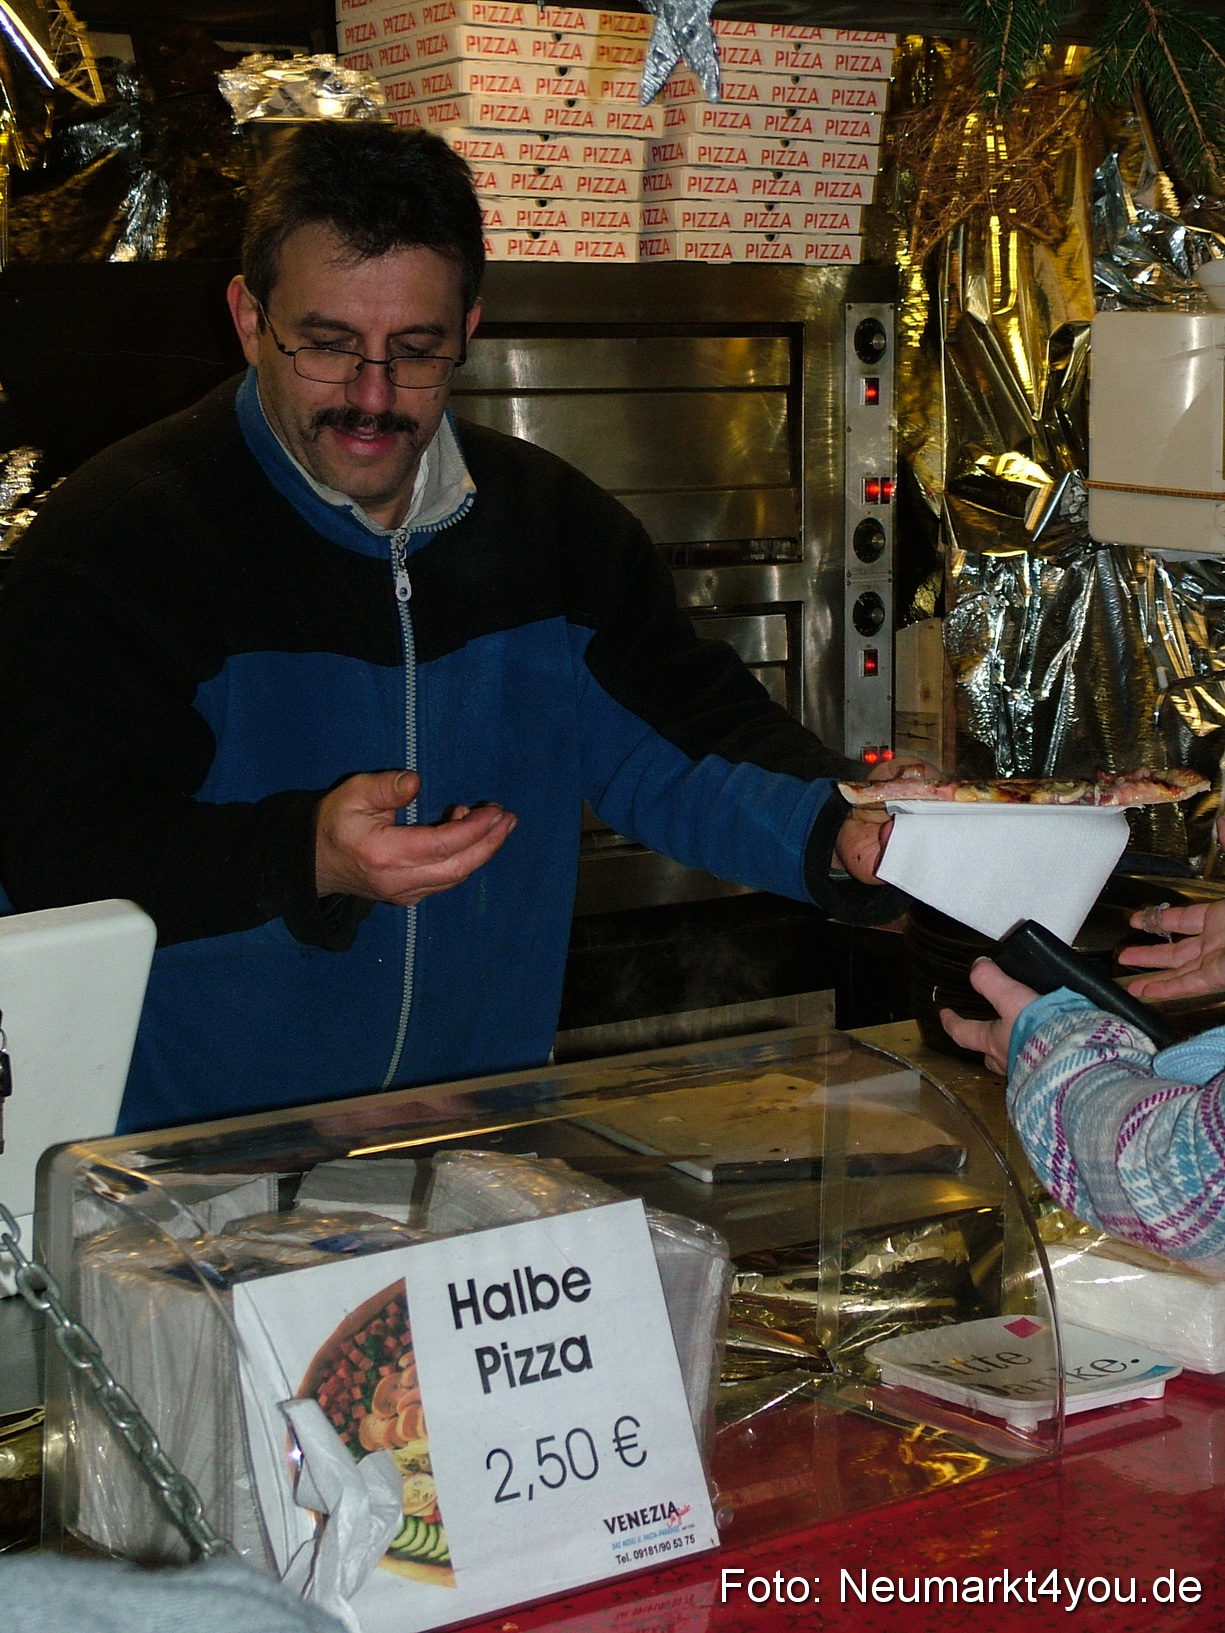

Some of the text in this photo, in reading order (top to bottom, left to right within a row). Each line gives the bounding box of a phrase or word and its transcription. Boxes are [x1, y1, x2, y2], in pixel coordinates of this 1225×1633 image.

[345, 2, 456, 45] PIZZA PIZZA PIZZA
[472, 4, 647, 33] PIZZA PIZZA PIZZA
[379, 43, 411, 66] PIZZA
[416, 34, 449, 56] PIZZA
[466, 35, 519, 56] PIZZA
[532, 41, 584, 61] PIZZA
[775, 50, 823, 70] PIZZA
[835, 55, 882, 73] PIZZA
[385, 73, 454, 102] PIZZA PIZZA
[470, 74, 638, 98] PIZZA PIZZA PIZZ
[719, 83, 877, 107] IZZA PIZZA PIZZA
[428, 102, 461, 124] PIZZA
[480, 104, 654, 131] PIZZA PIZZA PIZZA
[663, 109, 686, 127] ZZA
[702, 110, 871, 137] PIZZA PIZZA PIZZA
[453, 141, 633, 164] PIZZA PIZZA PIZZA
[651, 143, 684, 163] PIZZA
[697, 146, 869, 170] PIZZA PIZZA PIZZA
[511, 173, 563, 191] PIZZA
[576, 176, 628, 194] PIZZA
[642, 173, 672, 192] PIZZA
[687, 176, 862, 199] PIZZA PIZZA PIZZA
[517, 210, 568, 227] PIZZA
[581, 211, 631, 228] PIZZA
[682, 211, 850, 229] PIZZA PIZZA PIZZA
[508, 239, 561, 256] PIZZA
[574, 241, 626, 258] PIZZA
[639, 238, 671, 257] PIZZA
[684, 243, 852, 260] PIZZA PIZZA PIZZA
[448, 1265, 592, 1330] Halbe
[475, 1334, 593, 1395] Pizza
[485, 1415, 648, 1505] 2,50 €
[603, 1501, 679, 1534] VENEZIA
[616, 1535, 695, 1564] Tel. 09181/90 53 75
